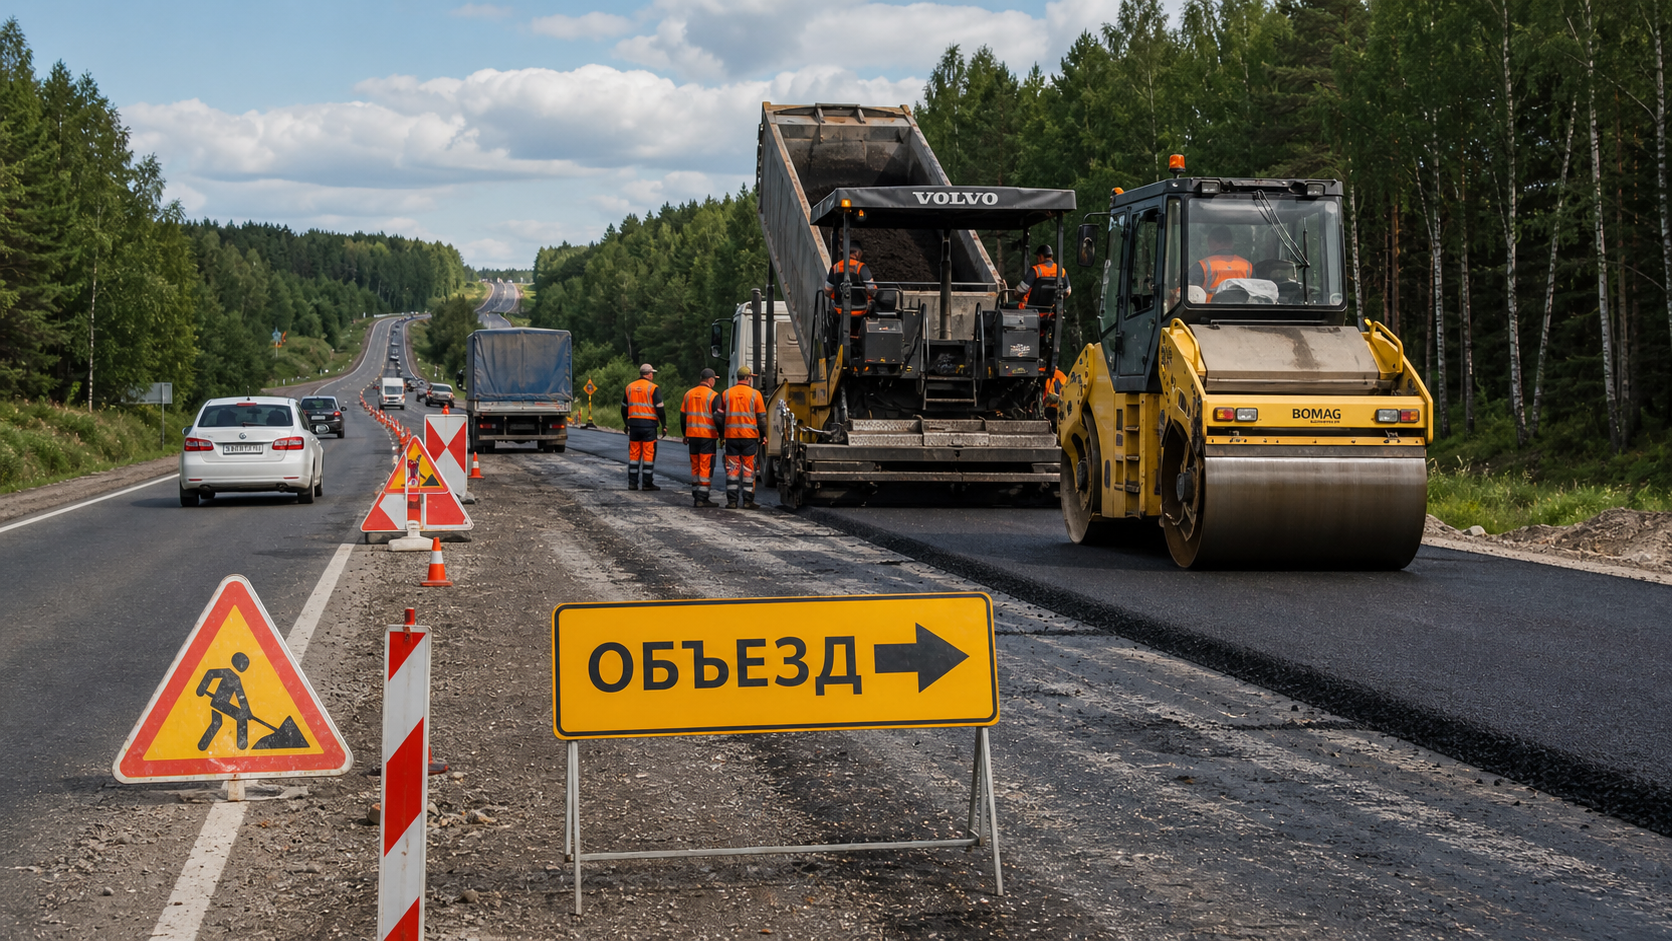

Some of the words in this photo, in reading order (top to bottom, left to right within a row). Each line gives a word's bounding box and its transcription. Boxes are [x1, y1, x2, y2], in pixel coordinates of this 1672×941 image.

[912, 191, 999, 206] VOLVO
[1292, 408, 1342, 420] BOMAG
[588, 635, 863, 697] ОБЪЕЗД
